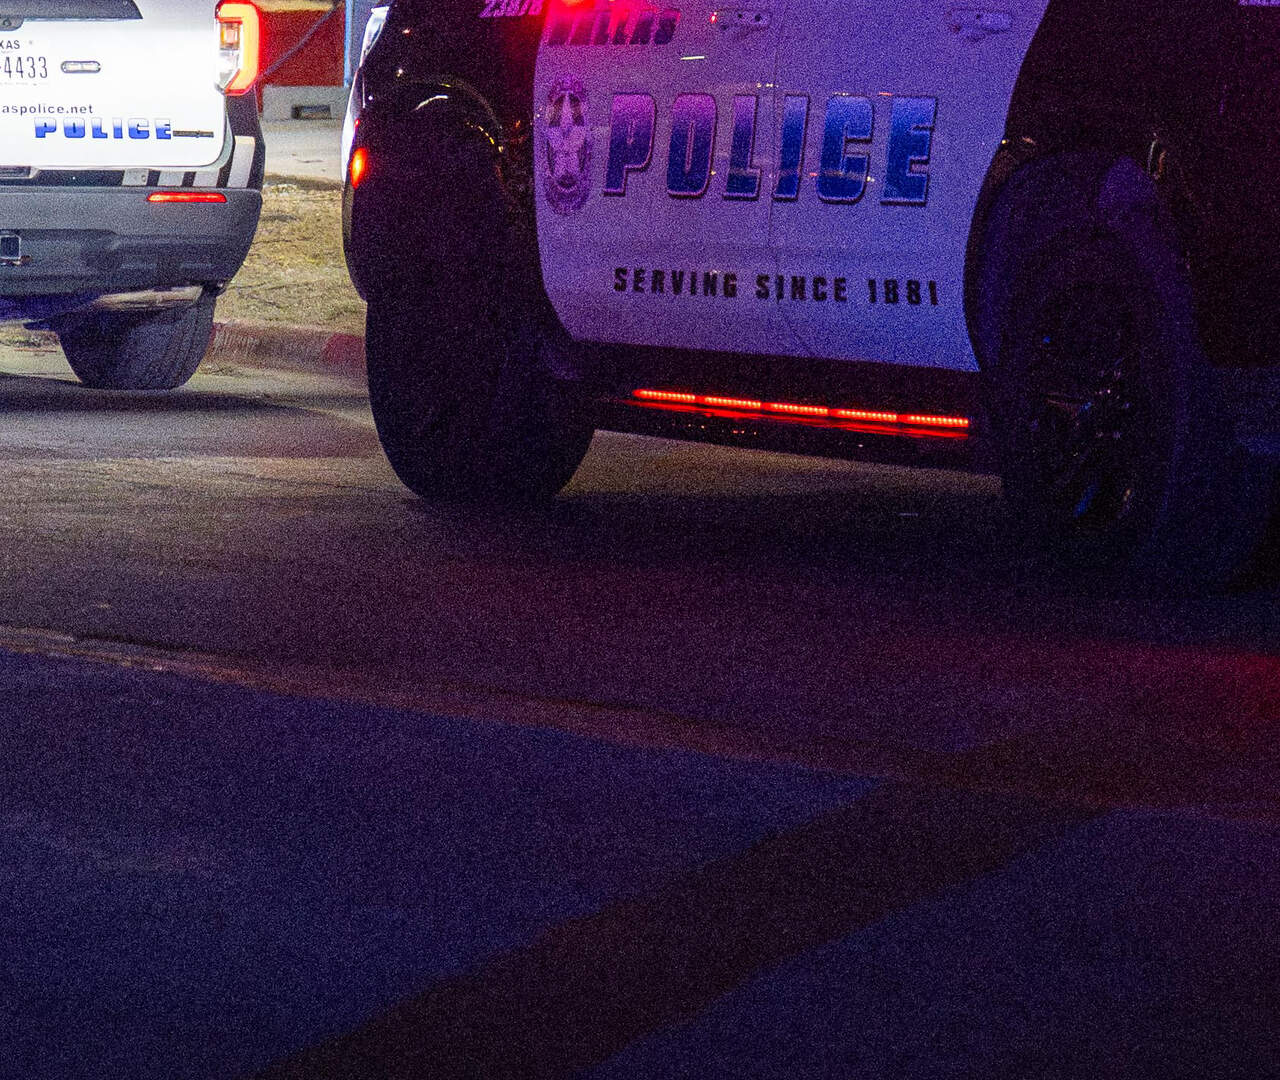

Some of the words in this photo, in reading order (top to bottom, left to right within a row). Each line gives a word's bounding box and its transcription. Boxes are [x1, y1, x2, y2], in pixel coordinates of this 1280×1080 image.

[35, 116, 172, 139] POLICE
[604, 92, 938, 208] POLICE
[613, 268, 738, 298] SERVING
[756, 274, 847, 303] SINCE
[868, 278, 939, 306] 1881
